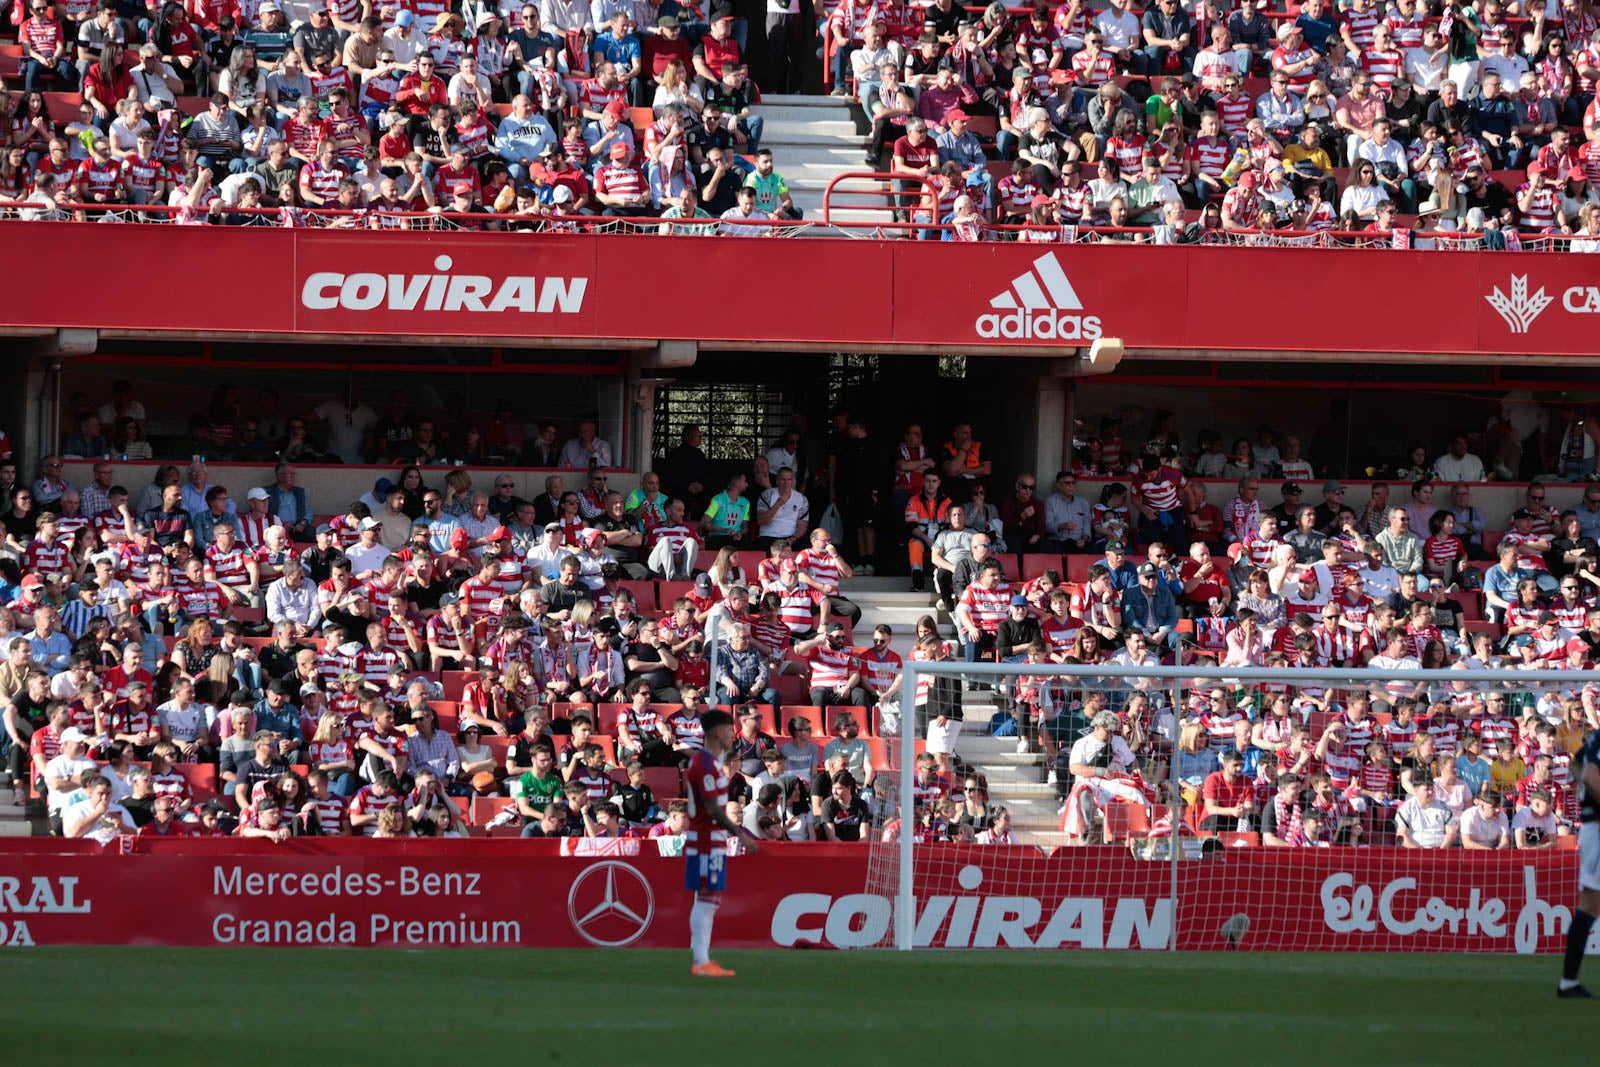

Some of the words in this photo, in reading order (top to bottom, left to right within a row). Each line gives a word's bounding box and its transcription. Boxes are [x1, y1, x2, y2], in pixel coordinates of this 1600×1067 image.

[975, 307, 1102, 339] adidas
[213, 865, 481, 897] Mercedes-Benz
[1320, 872, 1376, 933] El
[1378, 877, 1507, 938] Corte
[213, 913, 357, 944] Granada
[371, 912, 521, 944] Premium
